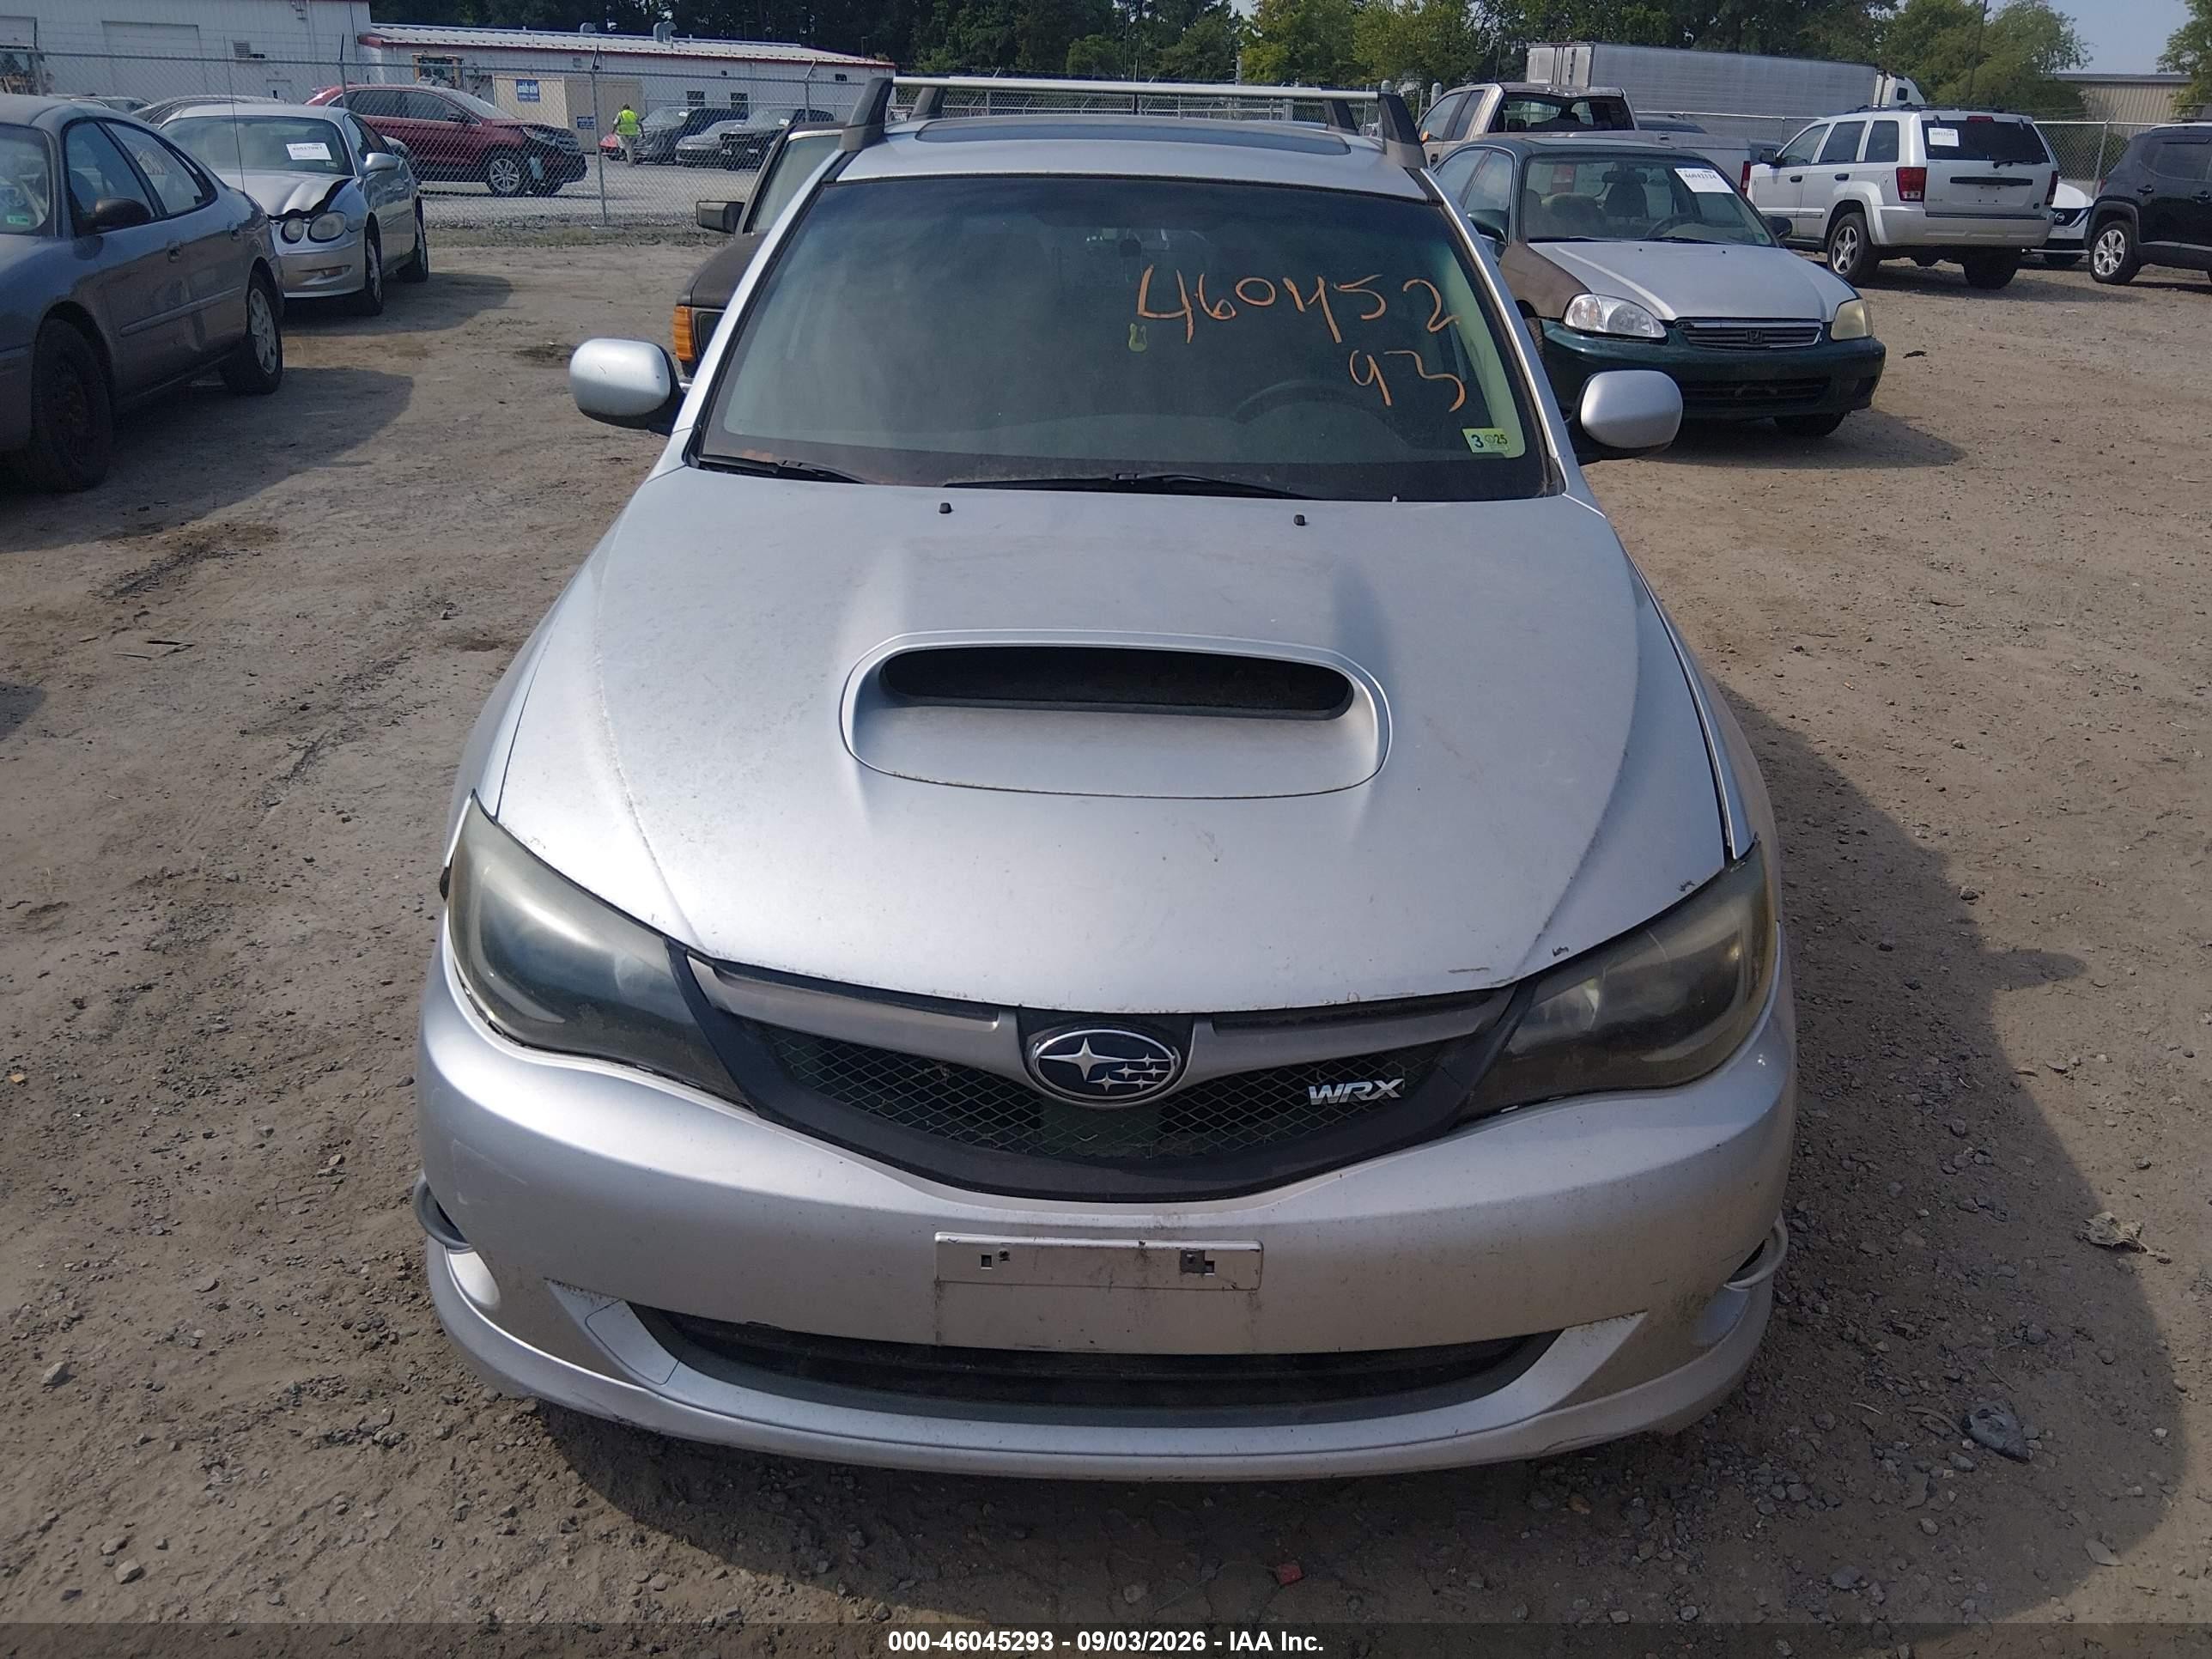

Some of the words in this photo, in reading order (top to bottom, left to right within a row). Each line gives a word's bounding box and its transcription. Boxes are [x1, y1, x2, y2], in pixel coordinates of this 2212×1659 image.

[1349, 349, 1466, 412] 93
[1471, 434, 1485, 448] 3
[1308, 1078, 1405, 1105] WRX
